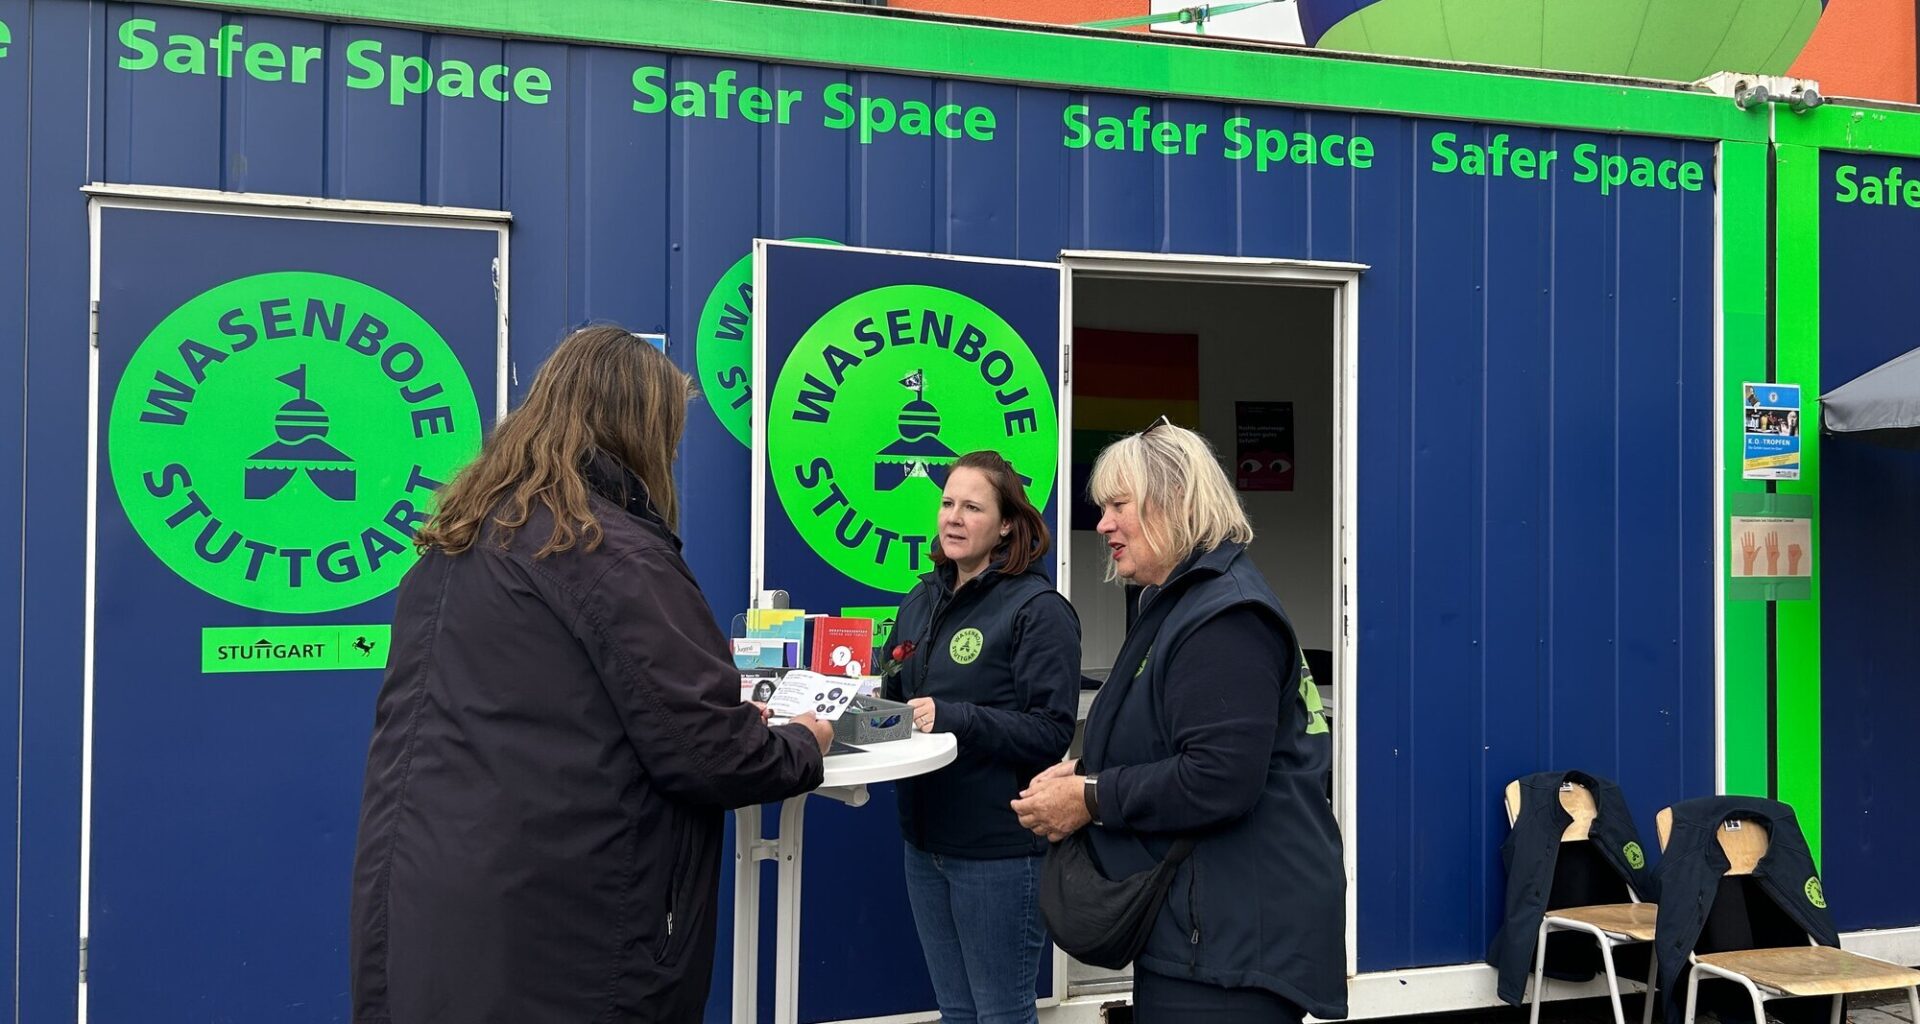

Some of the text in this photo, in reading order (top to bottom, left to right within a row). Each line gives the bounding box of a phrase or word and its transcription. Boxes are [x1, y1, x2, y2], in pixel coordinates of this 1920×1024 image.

[118, 18, 552, 106] Safer Space
[631, 65, 997, 145] Safer Space
[1063, 104, 1375, 173] Safer Space
[1431, 131, 1704, 196] Safer Space
[139, 298, 455, 438] WASENBOJE
[792, 309, 1038, 437] WASENBOJE
[143, 463, 450, 588] STUTTGART
[795, 457, 1032, 571] STUTT
[218, 638, 325, 660] STUTTGART
